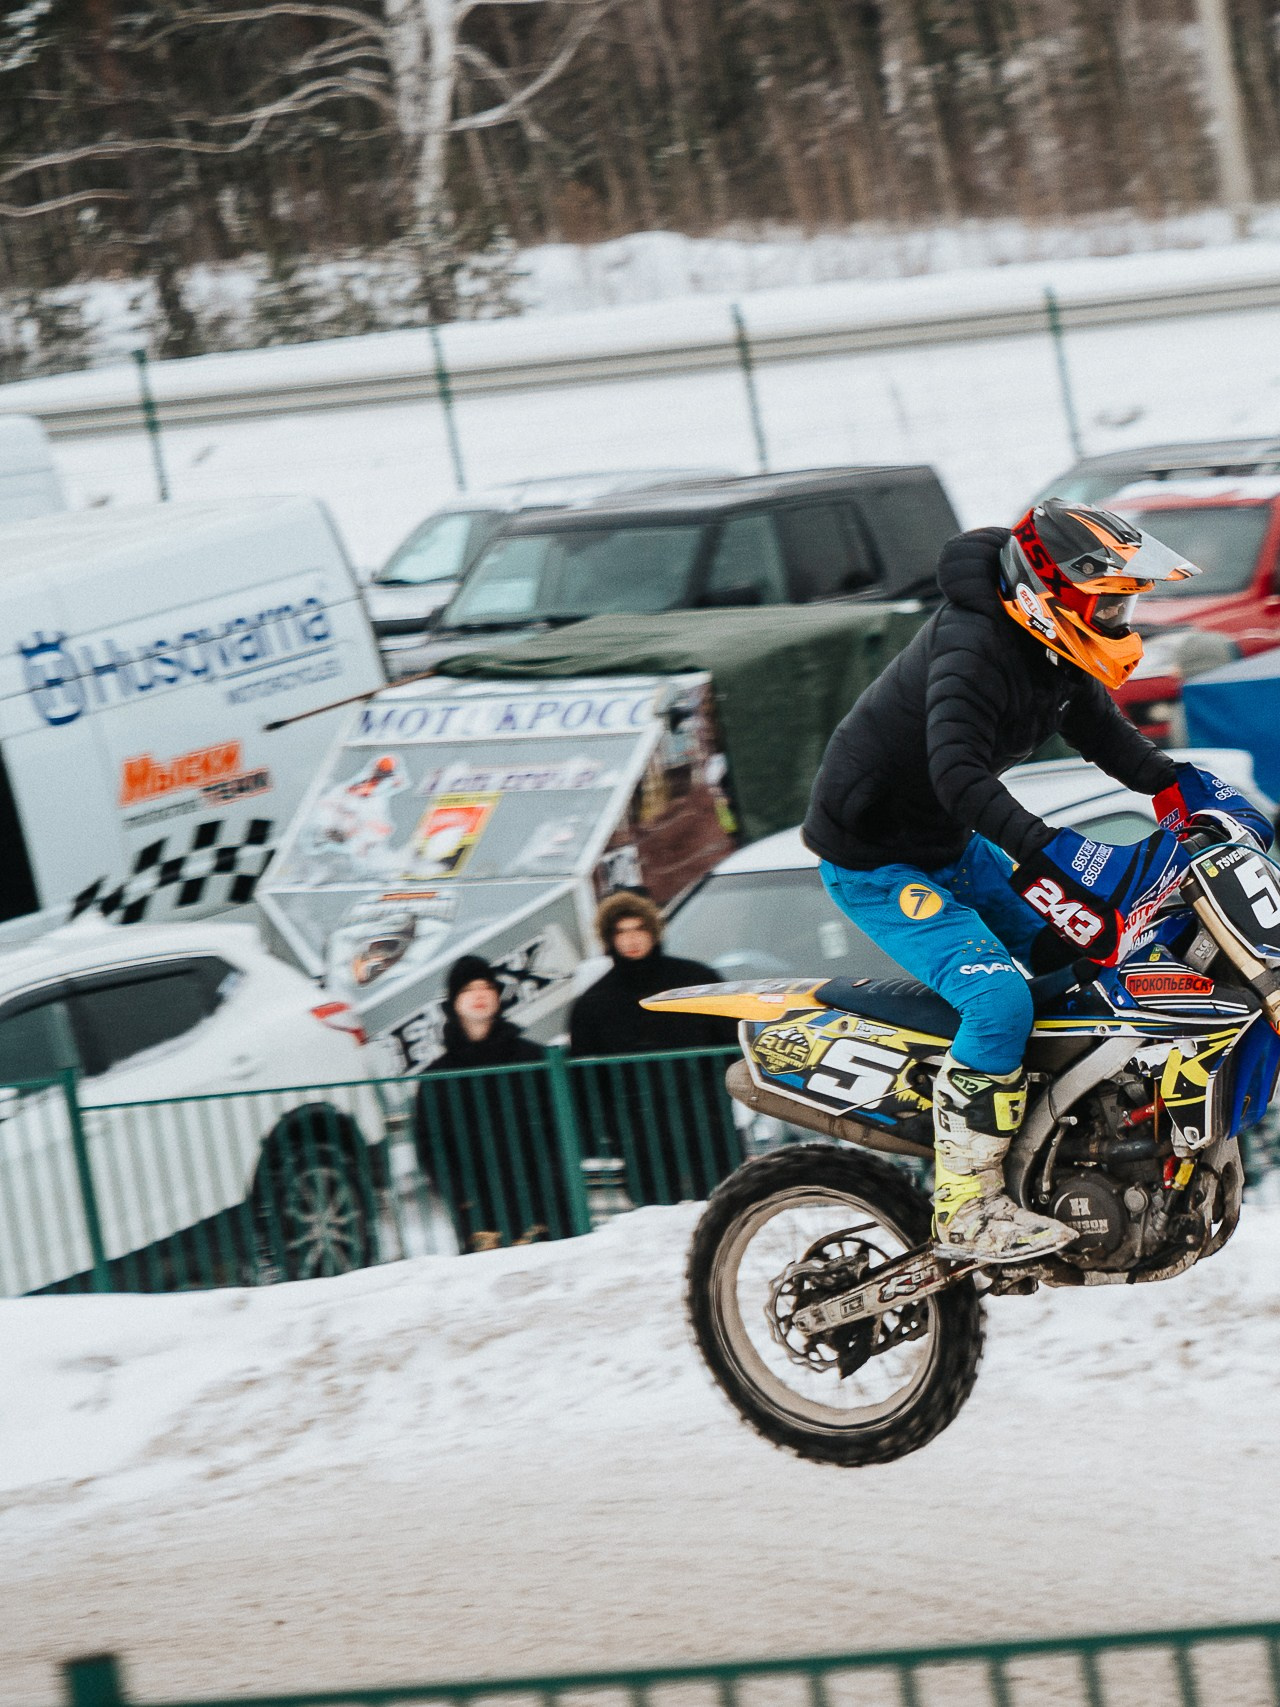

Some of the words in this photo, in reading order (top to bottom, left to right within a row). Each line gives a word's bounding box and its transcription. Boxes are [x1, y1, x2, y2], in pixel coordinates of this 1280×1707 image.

[1016, 523, 1074, 596] RSX
[80, 597, 329, 704] Husqvarna
[910, 888, 932, 916] 7
[1022, 876, 1104, 948] 243
[1129, 976, 1210, 993] ПРОКОПЬЕВСК
[759, 1034, 809, 1062] RUS
[807, 1038, 909, 1109] 5
[1069, 1197, 1091, 1217] H
